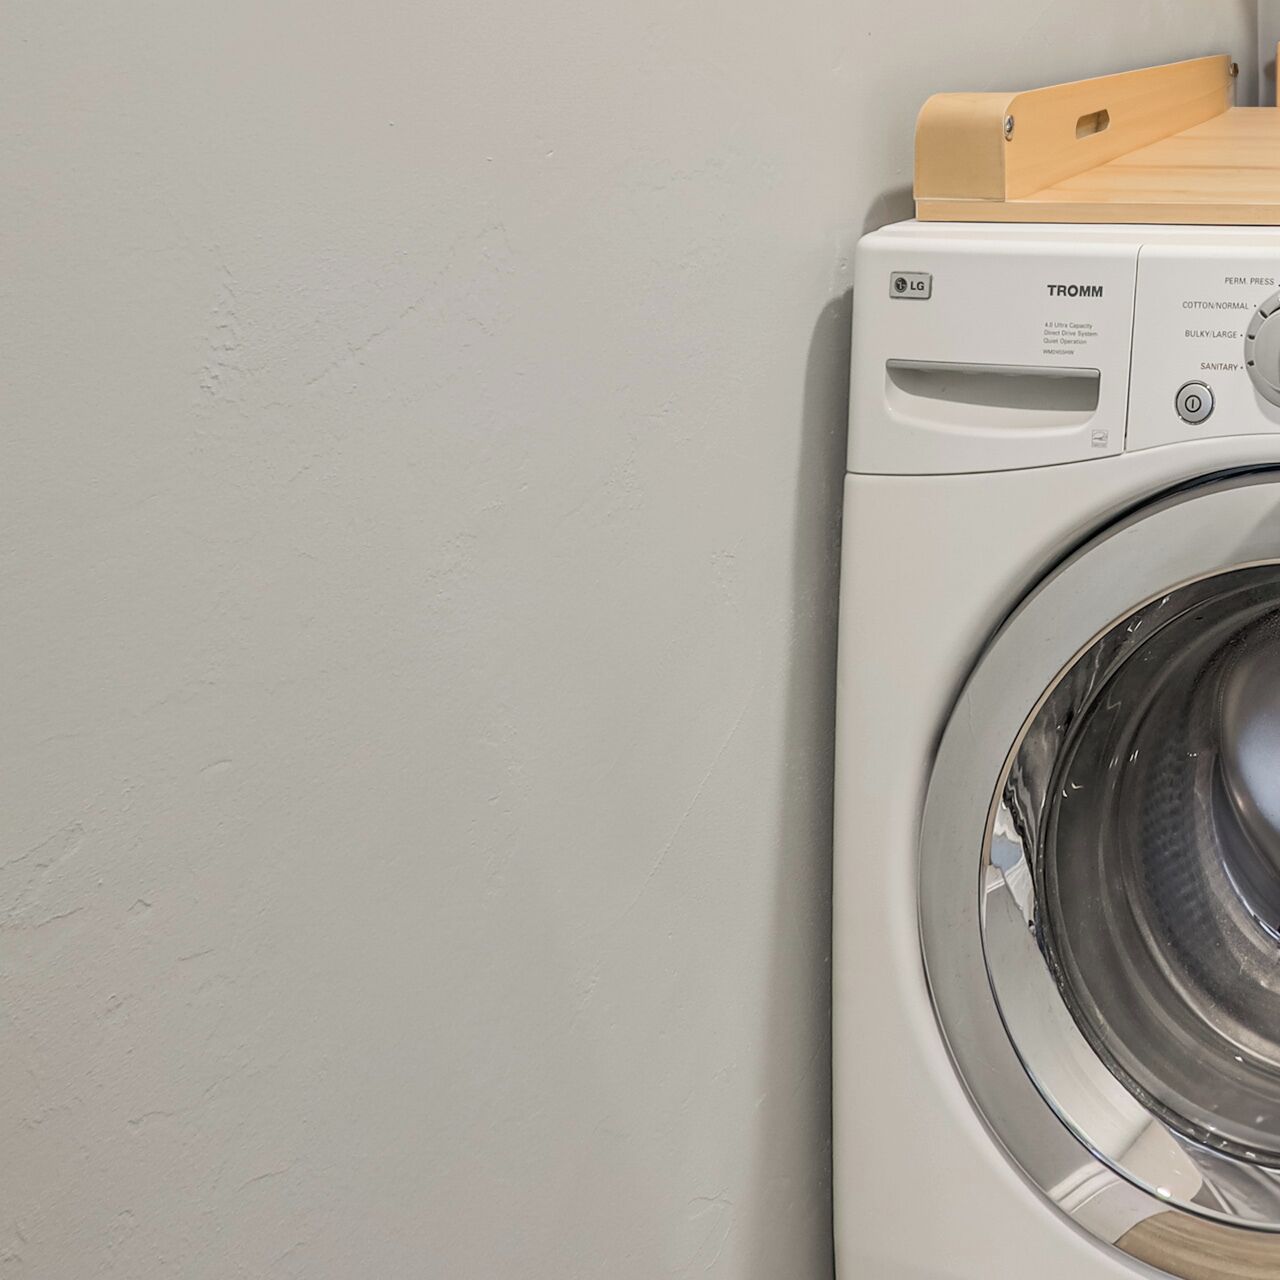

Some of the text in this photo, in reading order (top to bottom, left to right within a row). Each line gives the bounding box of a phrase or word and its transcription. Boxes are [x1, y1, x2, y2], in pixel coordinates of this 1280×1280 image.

[1224, 277, 1274, 285] PERM. PRESS
[911, 281, 925, 291] LG
[1047, 285, 1103, 297] TROMM
[1182, 301, 1249, 309] COTTON/NORMAL
[1185, 330, 1237, 338] BULKY/LARGE
[1200, 362, 1239, 371] SANITARY
